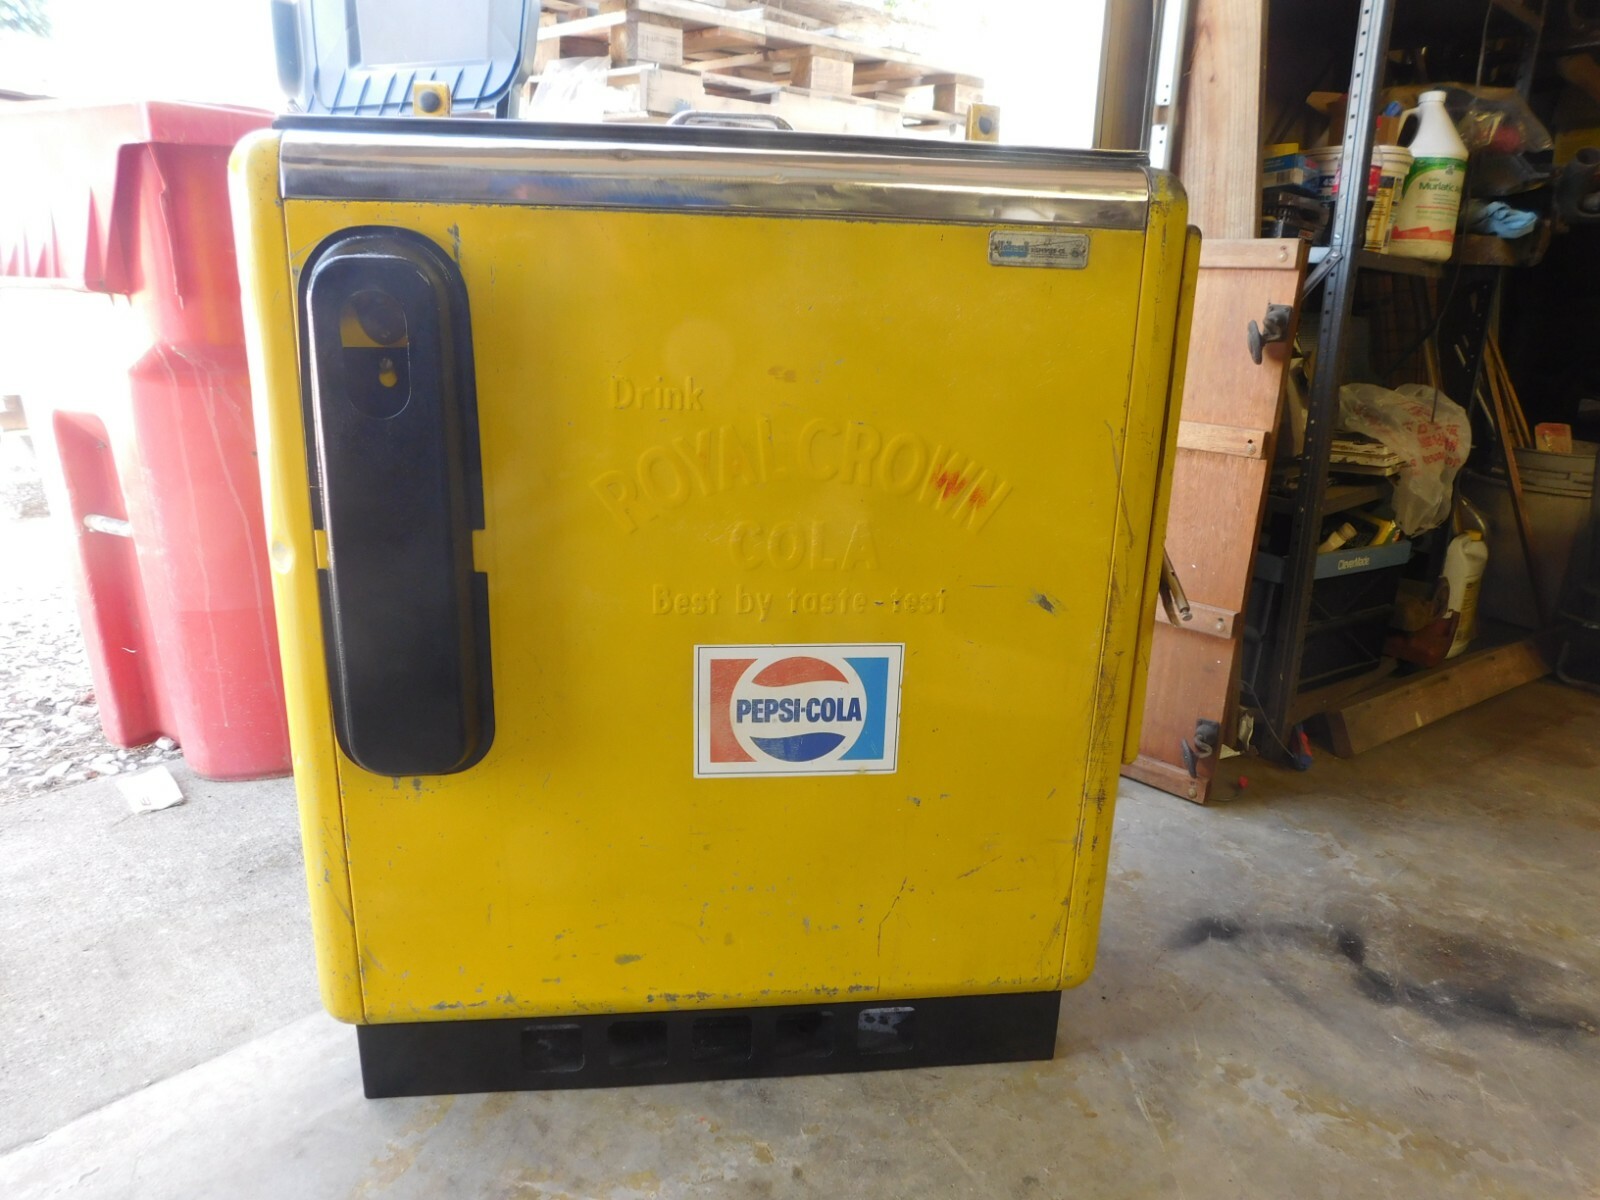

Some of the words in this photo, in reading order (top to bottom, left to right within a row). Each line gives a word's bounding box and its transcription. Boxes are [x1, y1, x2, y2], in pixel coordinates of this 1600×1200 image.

[611, 376, 704, 411] Drink
[589, 415, 787, 534] ROYAL
[799, 417, 1014, 534] CROWN
[728, 519, 880, 571] COLA
[652, 584, 721, 615] Best
[736, 584, 773, 622] by
[736, 697, 862, 723] PEPSI-COLA
